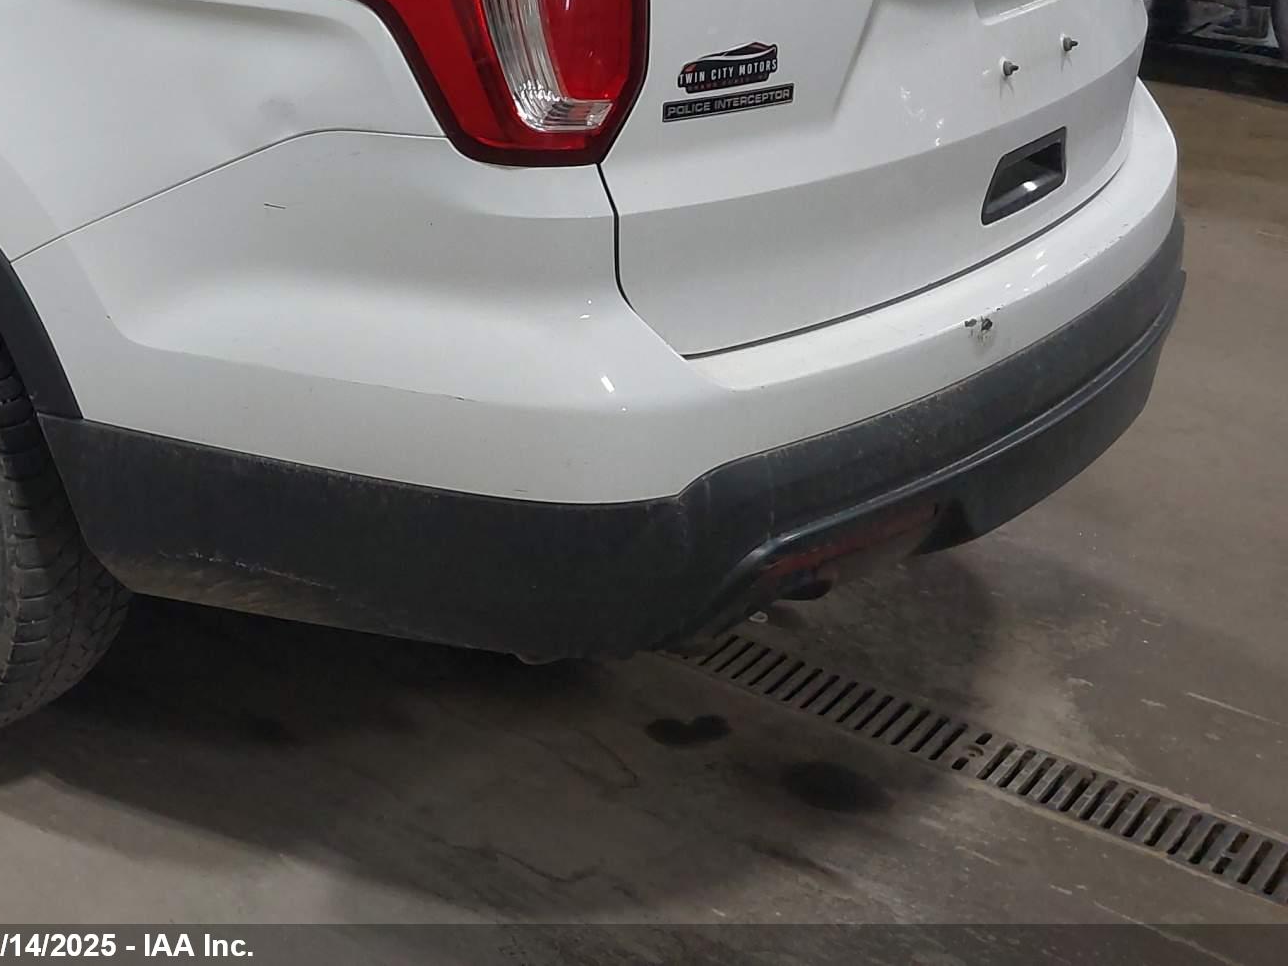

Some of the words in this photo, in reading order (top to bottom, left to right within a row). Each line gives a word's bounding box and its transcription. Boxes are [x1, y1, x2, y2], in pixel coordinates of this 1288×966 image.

[679, 71, 705, 85] TWIN
[711, 66, 734, 81] CITY
[739, 59, 777, 75] MOTORS
[667, 102, 711, 116] POLICE
[714, 89, 790, 110] INTERCEPTOR
